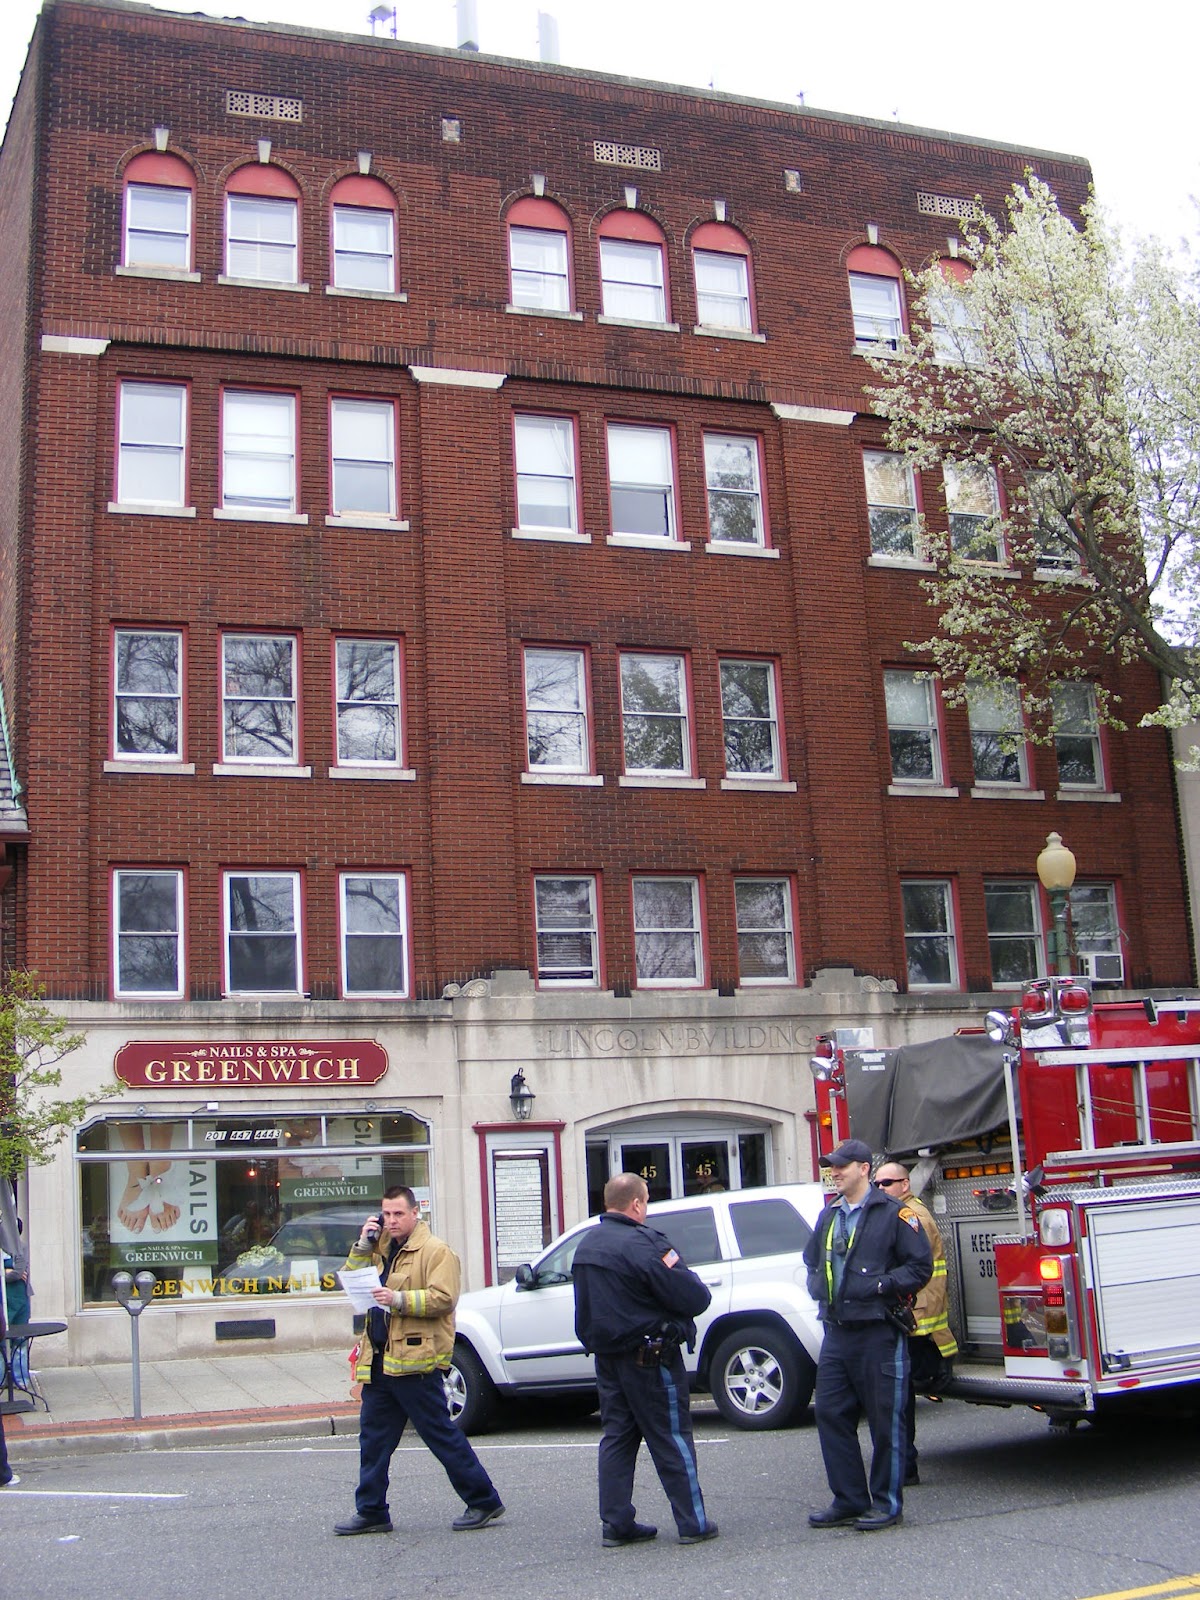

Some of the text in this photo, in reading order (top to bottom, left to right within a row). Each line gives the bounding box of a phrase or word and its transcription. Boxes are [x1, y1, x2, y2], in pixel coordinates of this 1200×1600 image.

[548, 1028, 675, 1053] LINCOLN
[209, 1046, 297, 1058] NAILS & SPA
[144, 1058, 361, 1083] GREENWICH
[206, 1129, 281, 1140] 201 447 4443
[639, 1166, 657, 1179] 45
[695, 1163, 712, 1176] 45
[188, 1160, 208, 1234] AILS
[293, 1185, 369, 1198] GREENWICH
[125, 1250, 203, 1262] GREENWICH
[131, 1277, 259, 1297] EENWICH
[267, 1273, 336, 1291] NAILS
